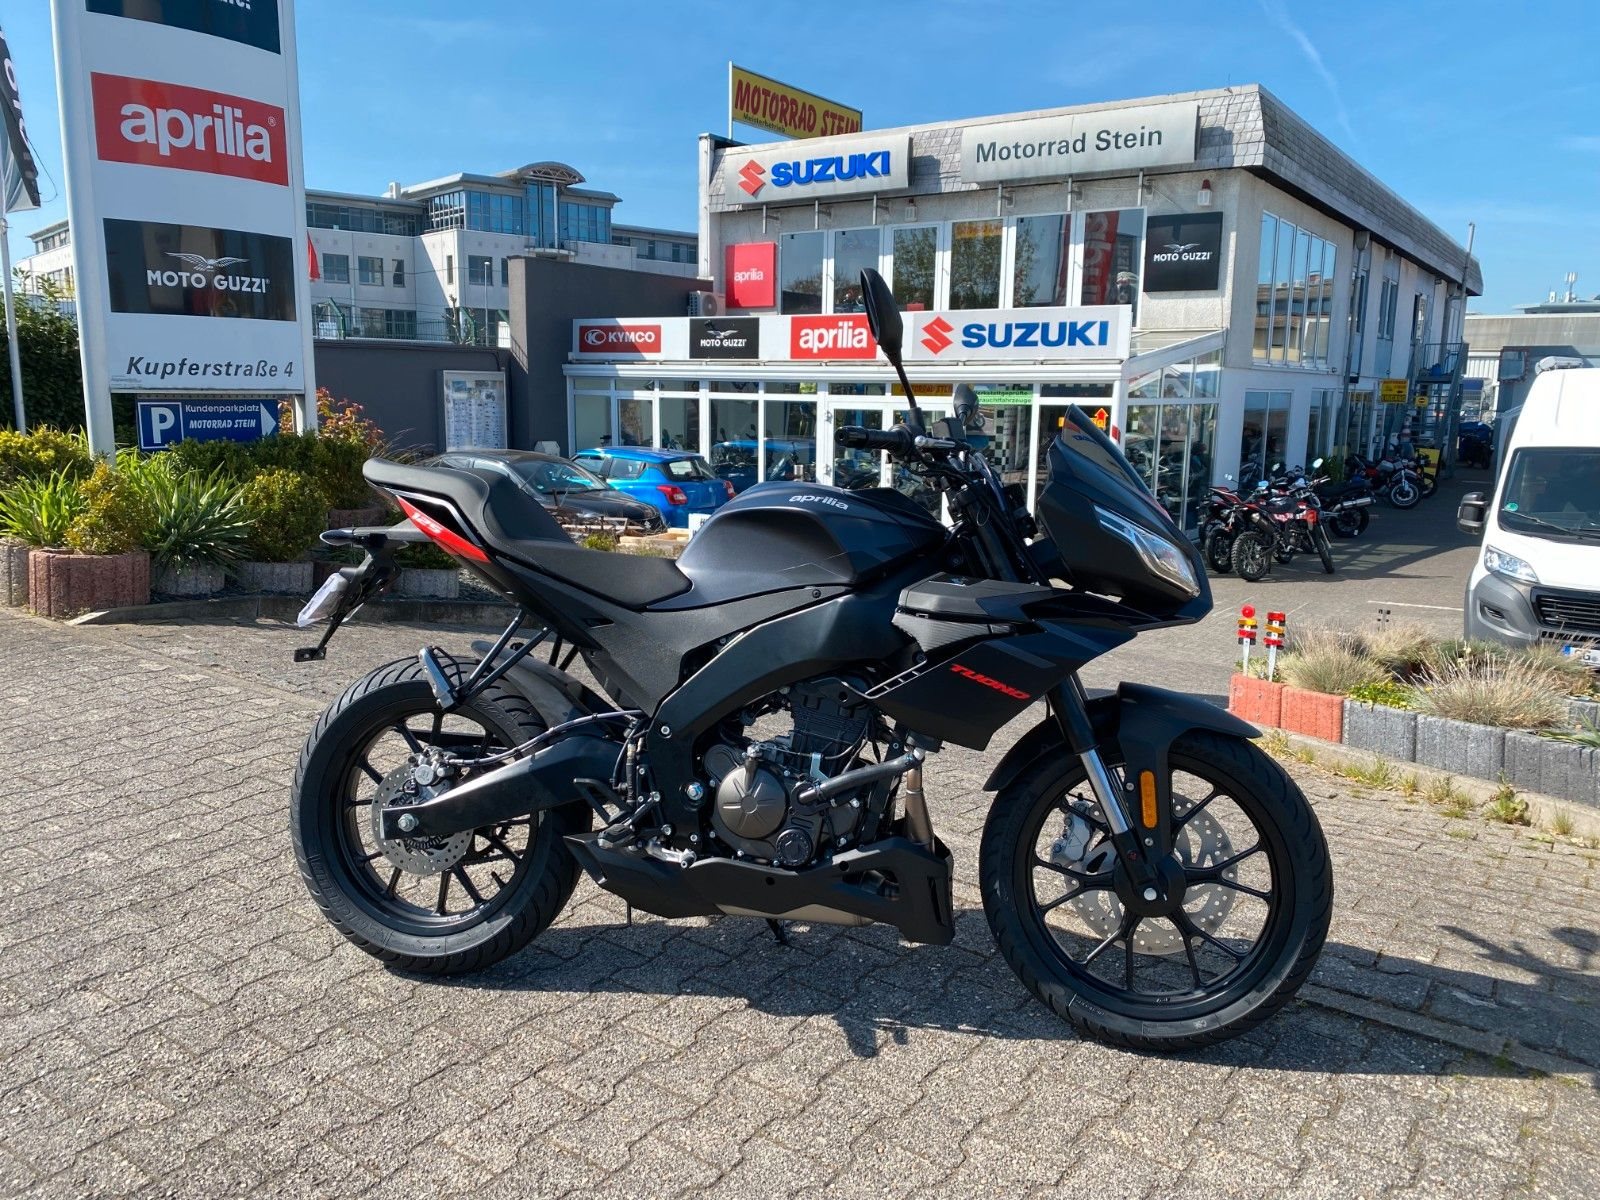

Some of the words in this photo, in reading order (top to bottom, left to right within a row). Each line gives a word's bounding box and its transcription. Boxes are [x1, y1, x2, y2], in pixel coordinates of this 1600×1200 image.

[735, 79, 817, 133] MOTORRAD
[120, 103, 272, 163] aprilia
[743, 113, 786, 133] Meisterbetrieb
[975, 132, 1086, 164] Motorrad
[1095, 126, 1163, 151] Stein
[771, 150, 891, 187] SUZUKI
[1153, 253, 1179, 262] MOTO
[1181, 251, 1210, 261] GUZZI
[146, 269, 207, 289] MOTO
[213, 274, 266, 293] GUZZI
[734, 267, 764, 283] aprilia
[608, 331, 656, 343] KYMCO
[700, 338, 721, 348] MOTO
[722, 338, 745, 348] GUZZI
[799, 320, 868, 353] aprilia
[961, 320, 1110, 349] SUZUKI
[126, 356, 278, 380] Kupferstraße
[284, 361, 294, 378] 4
[185, 404, 260, 414] Kundenparkplatz
[150, 406, 175, 444] P
[189, 419, 233, 429] MOTORRAD
[234, 419, 256, 428] STEIN
[788, 495, 849, 511] aprilia
